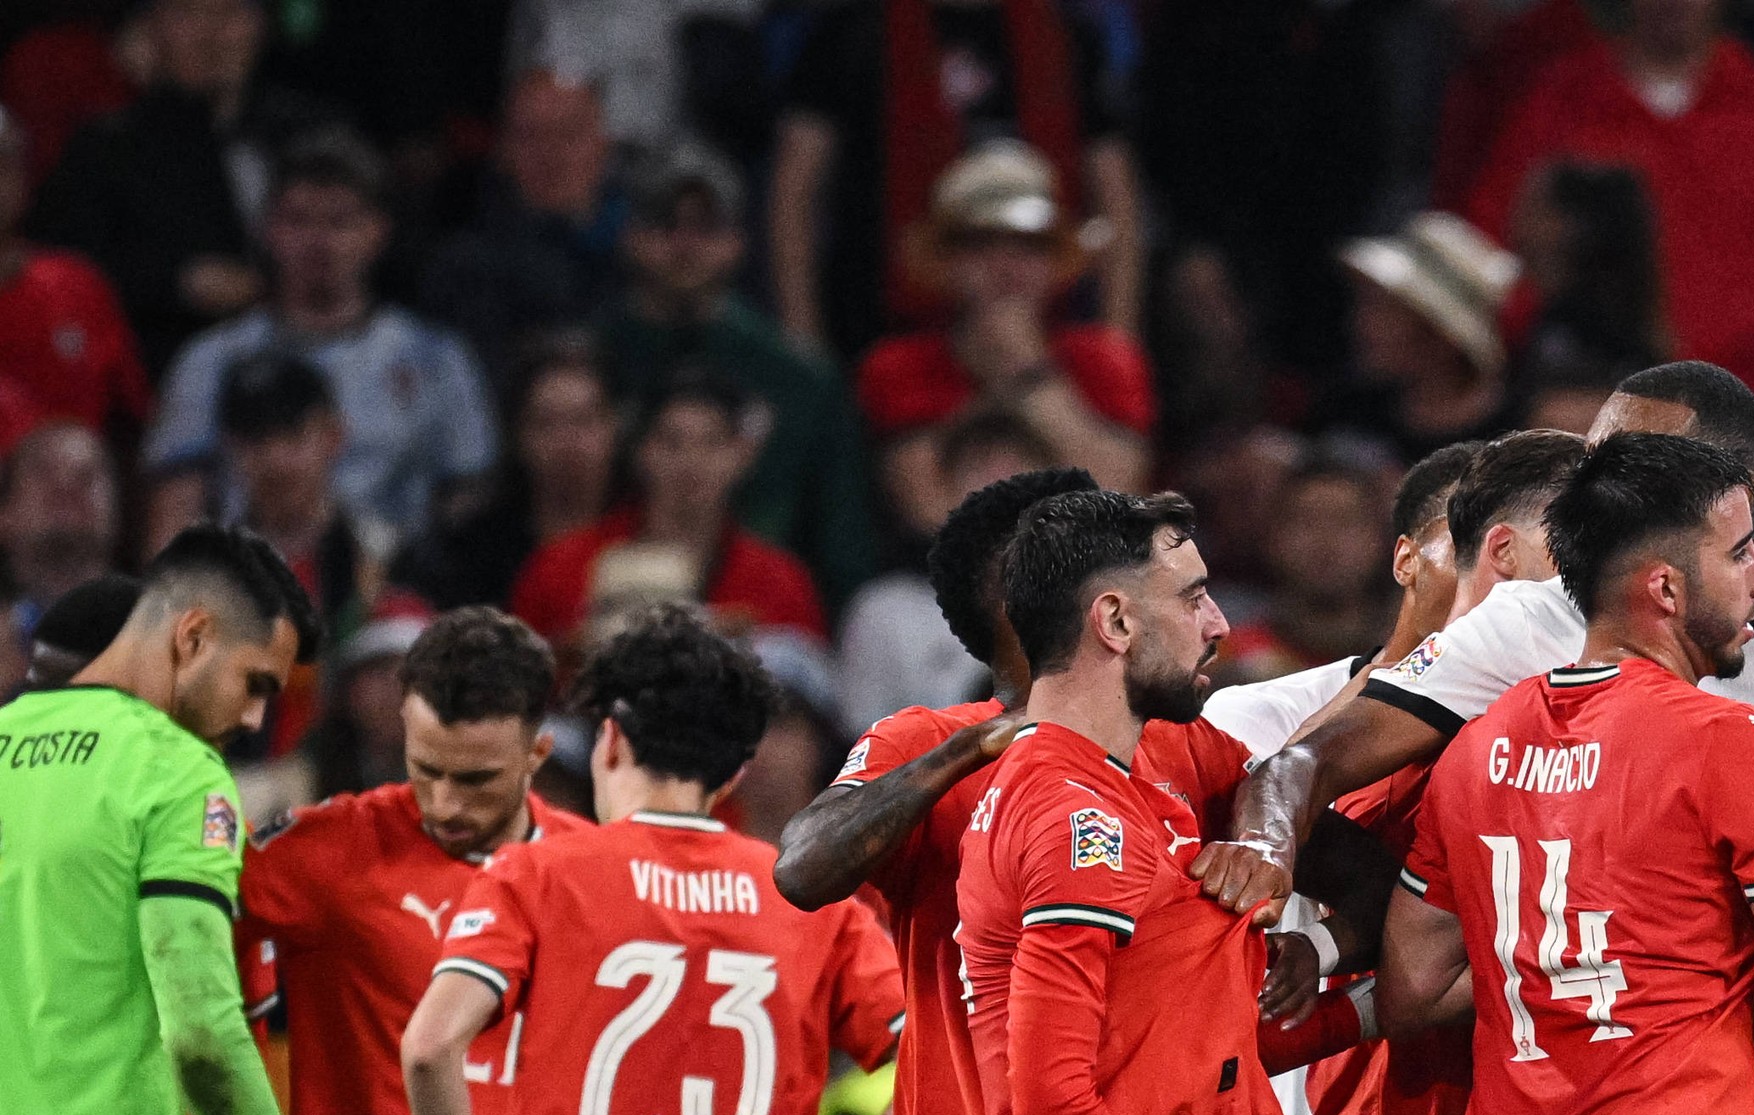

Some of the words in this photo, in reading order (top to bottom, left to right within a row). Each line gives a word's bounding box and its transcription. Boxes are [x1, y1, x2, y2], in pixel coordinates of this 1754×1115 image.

[11, 730, 100, 769] COSTA
[630, 858, 759, 915] VITINHA
[1478, 835, 1635, 1063] 14
